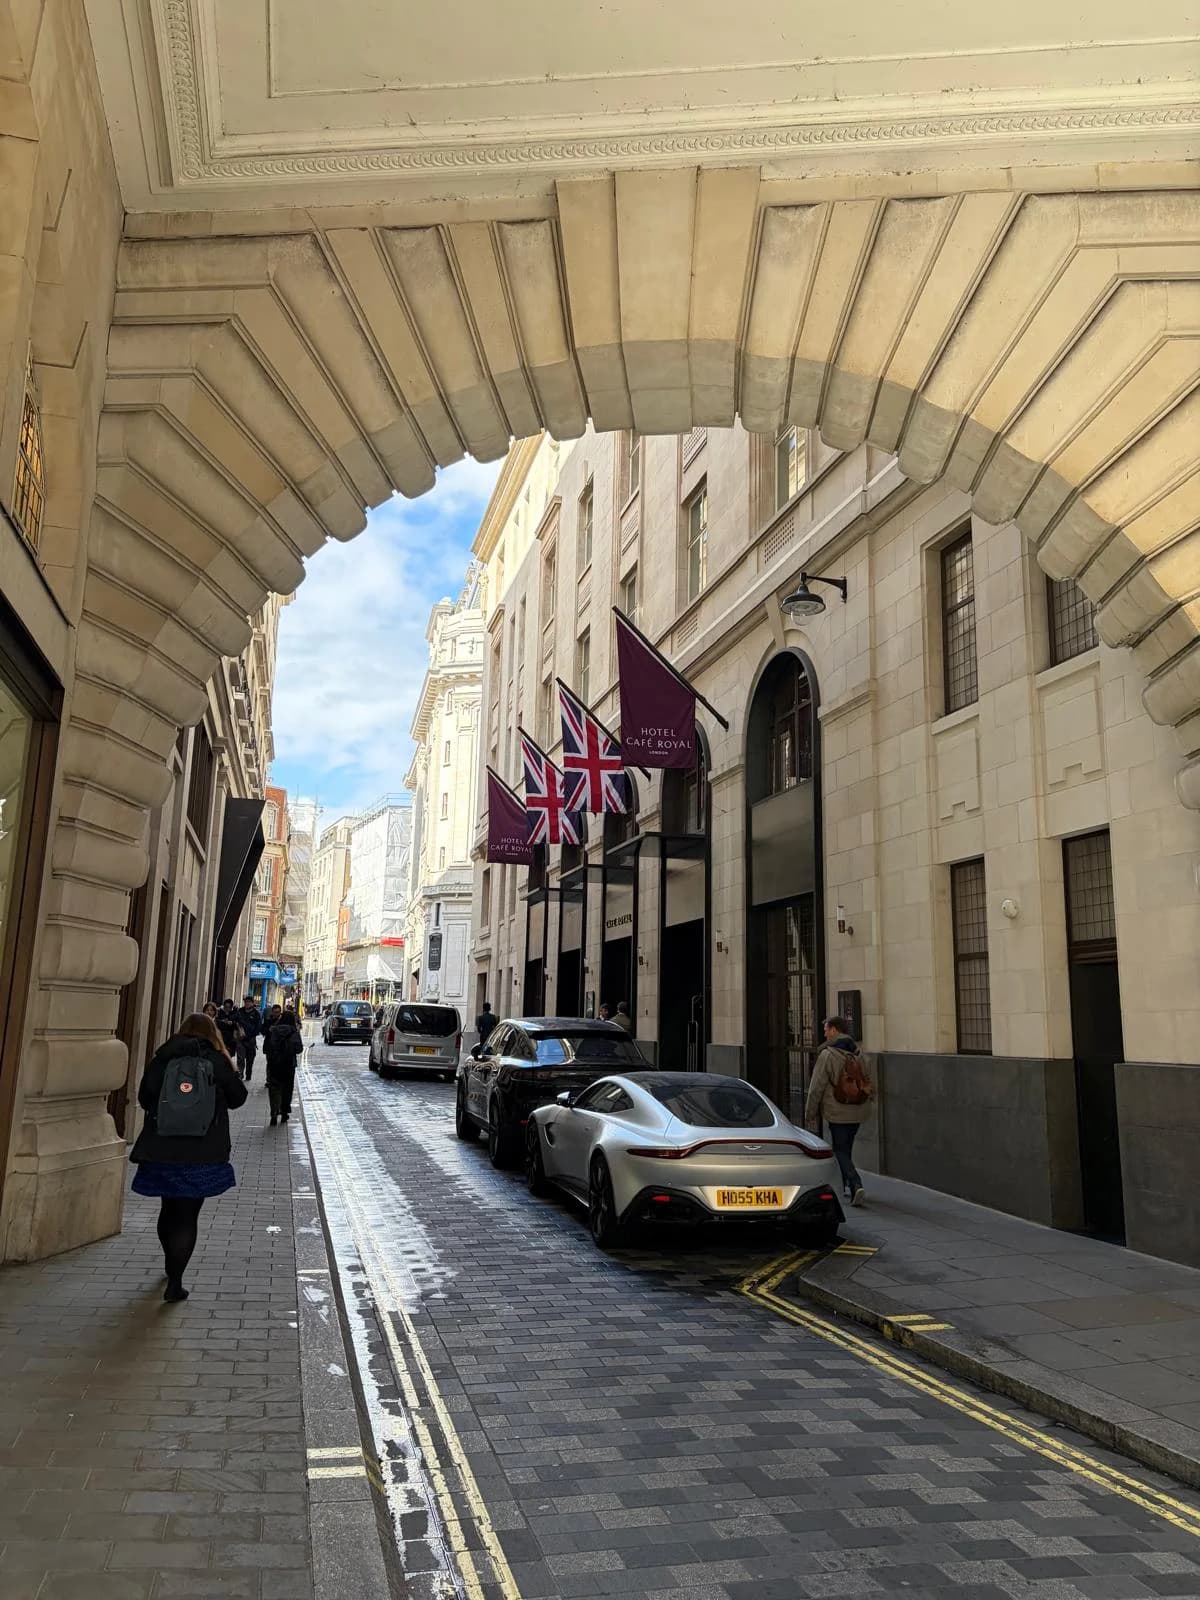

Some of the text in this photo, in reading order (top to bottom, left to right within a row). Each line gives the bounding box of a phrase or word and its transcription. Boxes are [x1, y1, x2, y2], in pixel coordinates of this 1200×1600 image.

[641, 727, 676, 737] HOTEL
[626, 737, 692, 749] CAFÉ ROYAL
[501, 837, 524, 845] HOTEL
[511, 845, 533, 853] ROYAL
[755, 1191, 778, 1204] KHA
